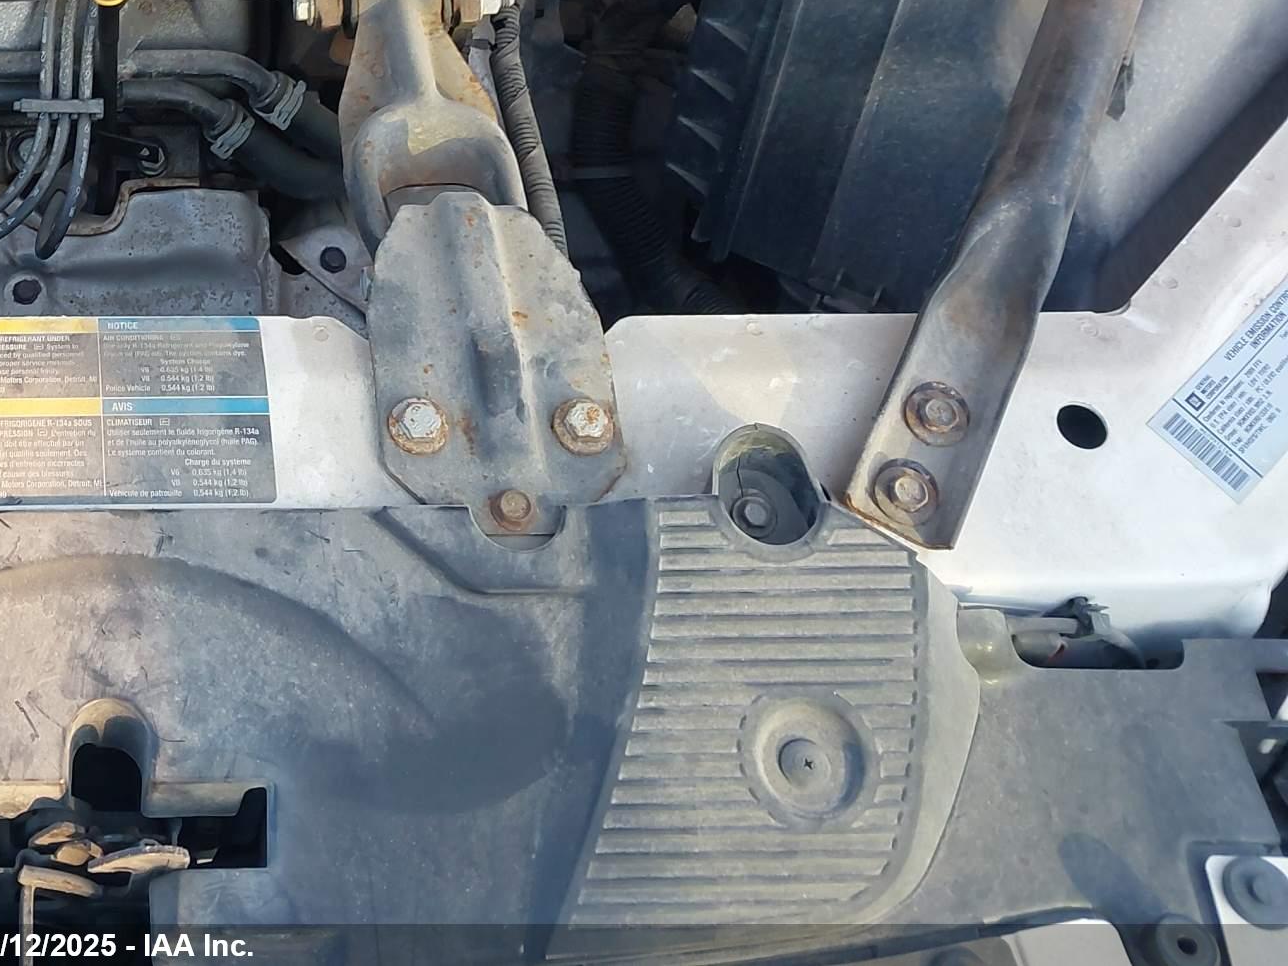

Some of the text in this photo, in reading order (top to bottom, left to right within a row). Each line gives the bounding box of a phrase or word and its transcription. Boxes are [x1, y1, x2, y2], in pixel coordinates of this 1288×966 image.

[108, 322, 138, 330] NOTICE
[1250, 311, 1286, 348] INFORMATION
[1224, 311, 1271, 361] VEHICLE EMISSION
[112, 402, 133, 411] AVIS
[107, 418, 153, 426] CLIMATISEUR
[132, 428, 166, 436] seulement
[184, 458, 210, 467] Charge
[212, 458, 220, 466] du
[172, 468, 180, 476] V6
